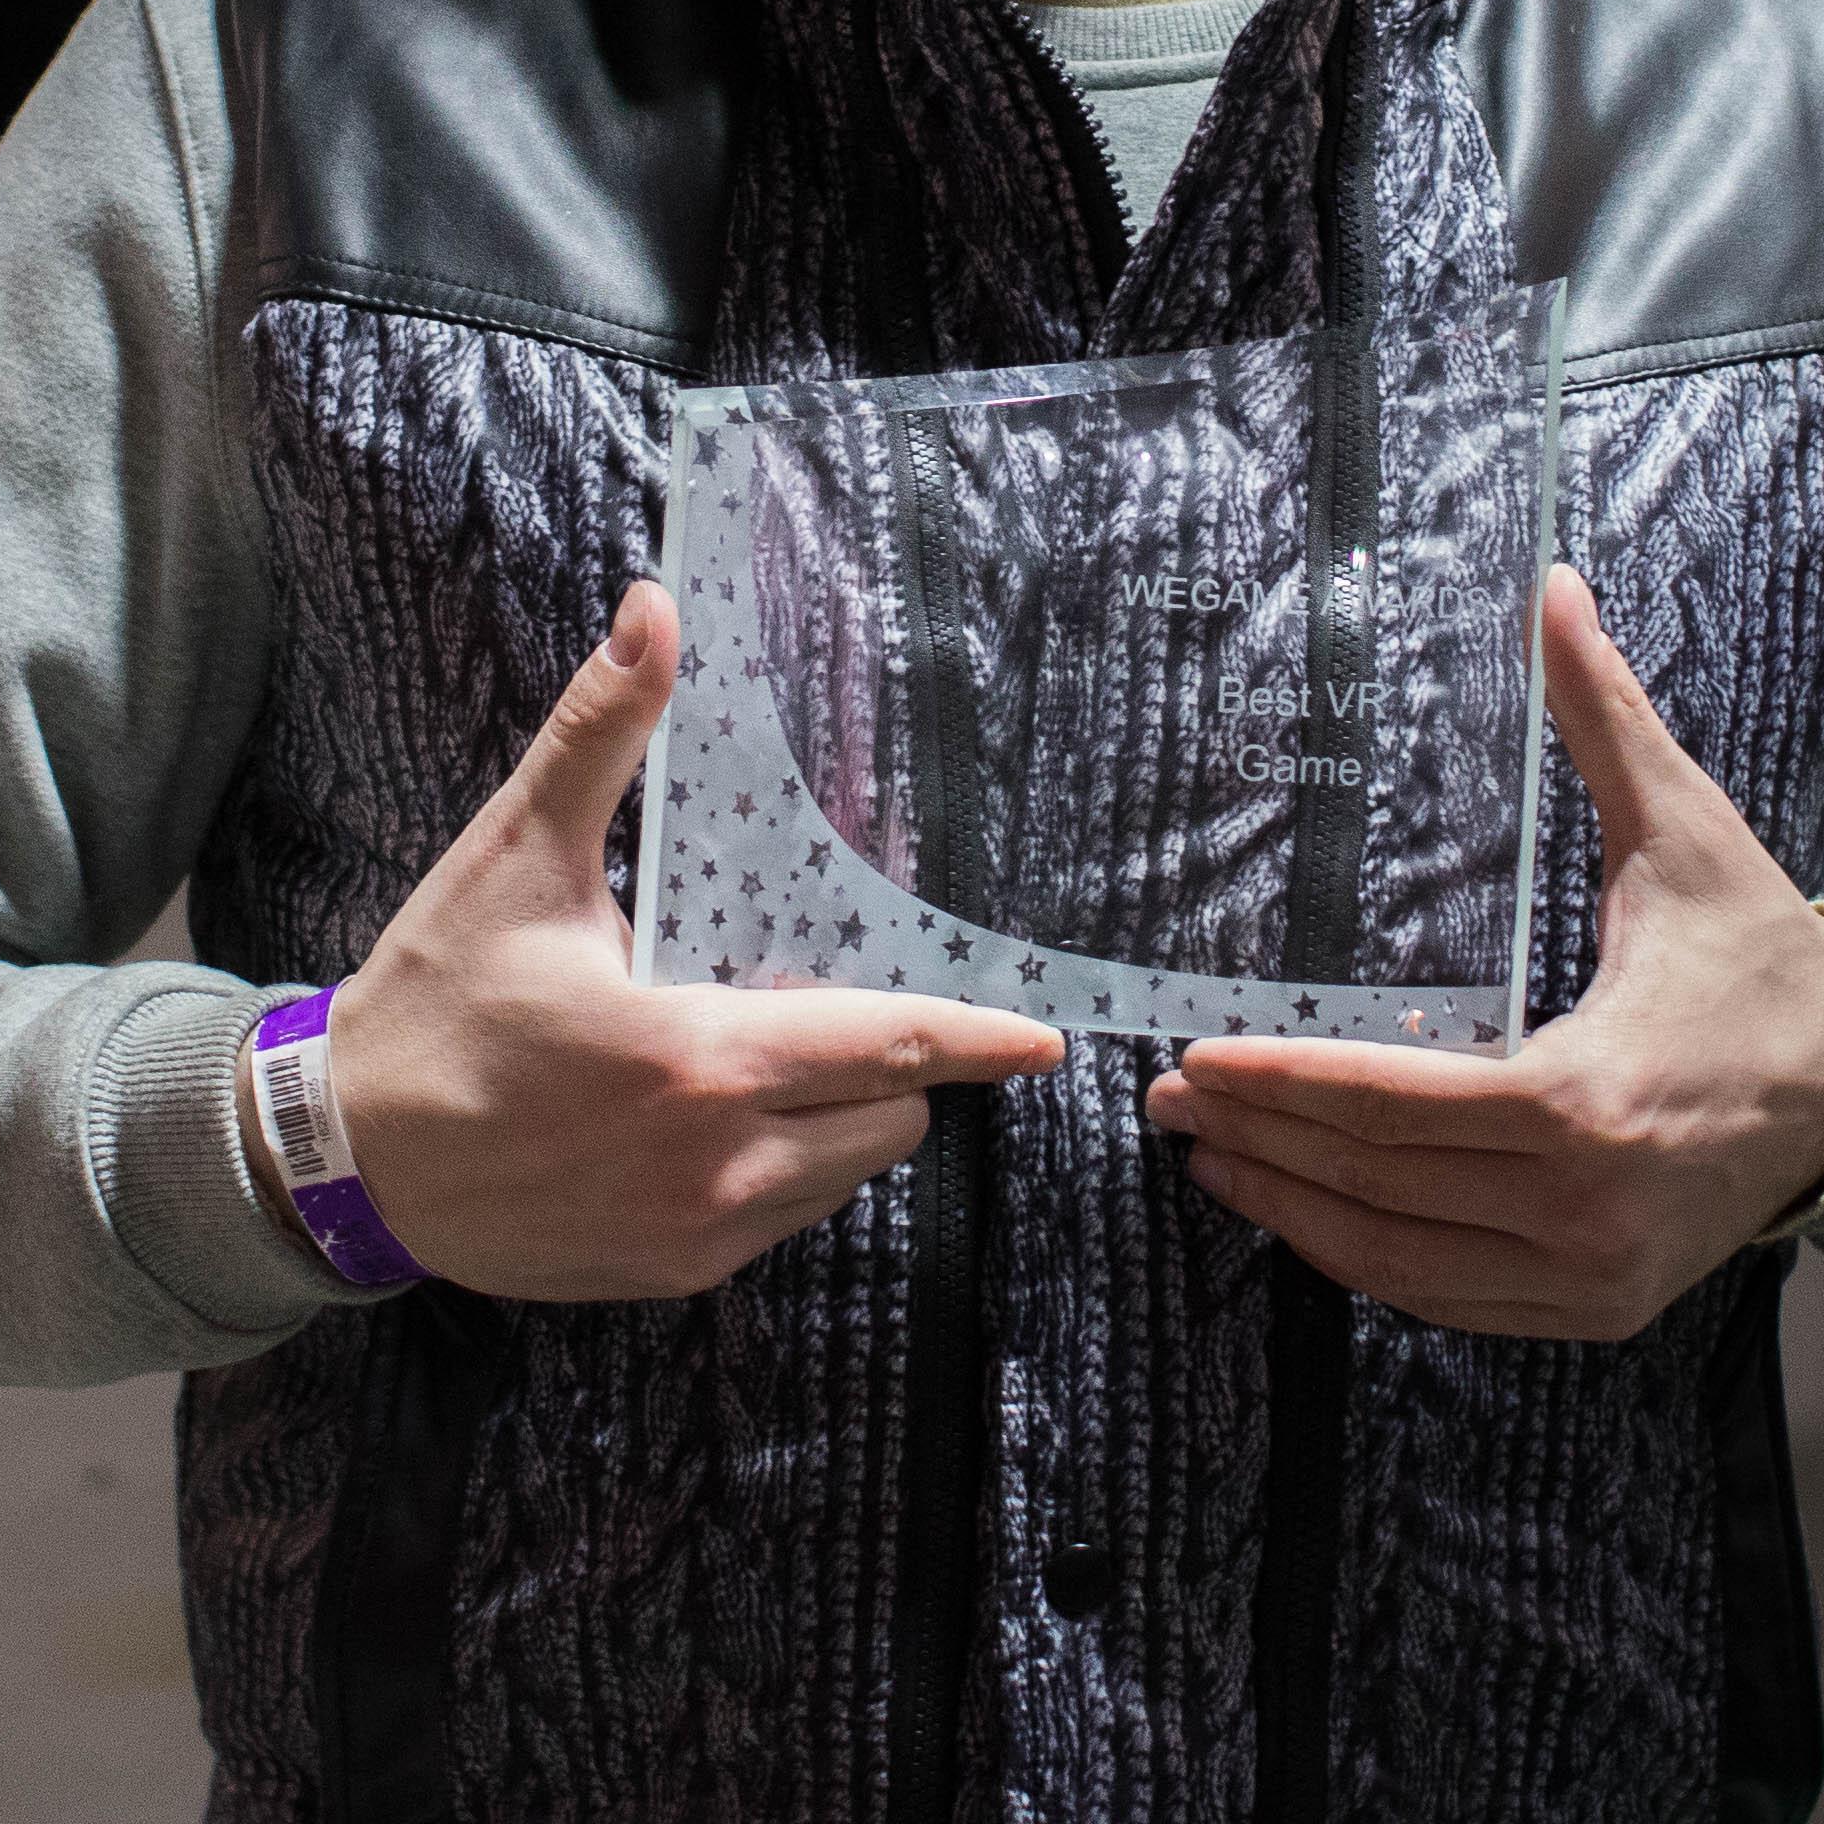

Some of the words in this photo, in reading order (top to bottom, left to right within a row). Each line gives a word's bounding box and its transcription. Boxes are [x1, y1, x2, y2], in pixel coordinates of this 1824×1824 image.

[1121, 572, 1310, 615] WEGAME
[1217, 675, 1312, 717] Best
[1326, 680, 1398, 719] VR
[1236, 743, 1363, 786] Game
